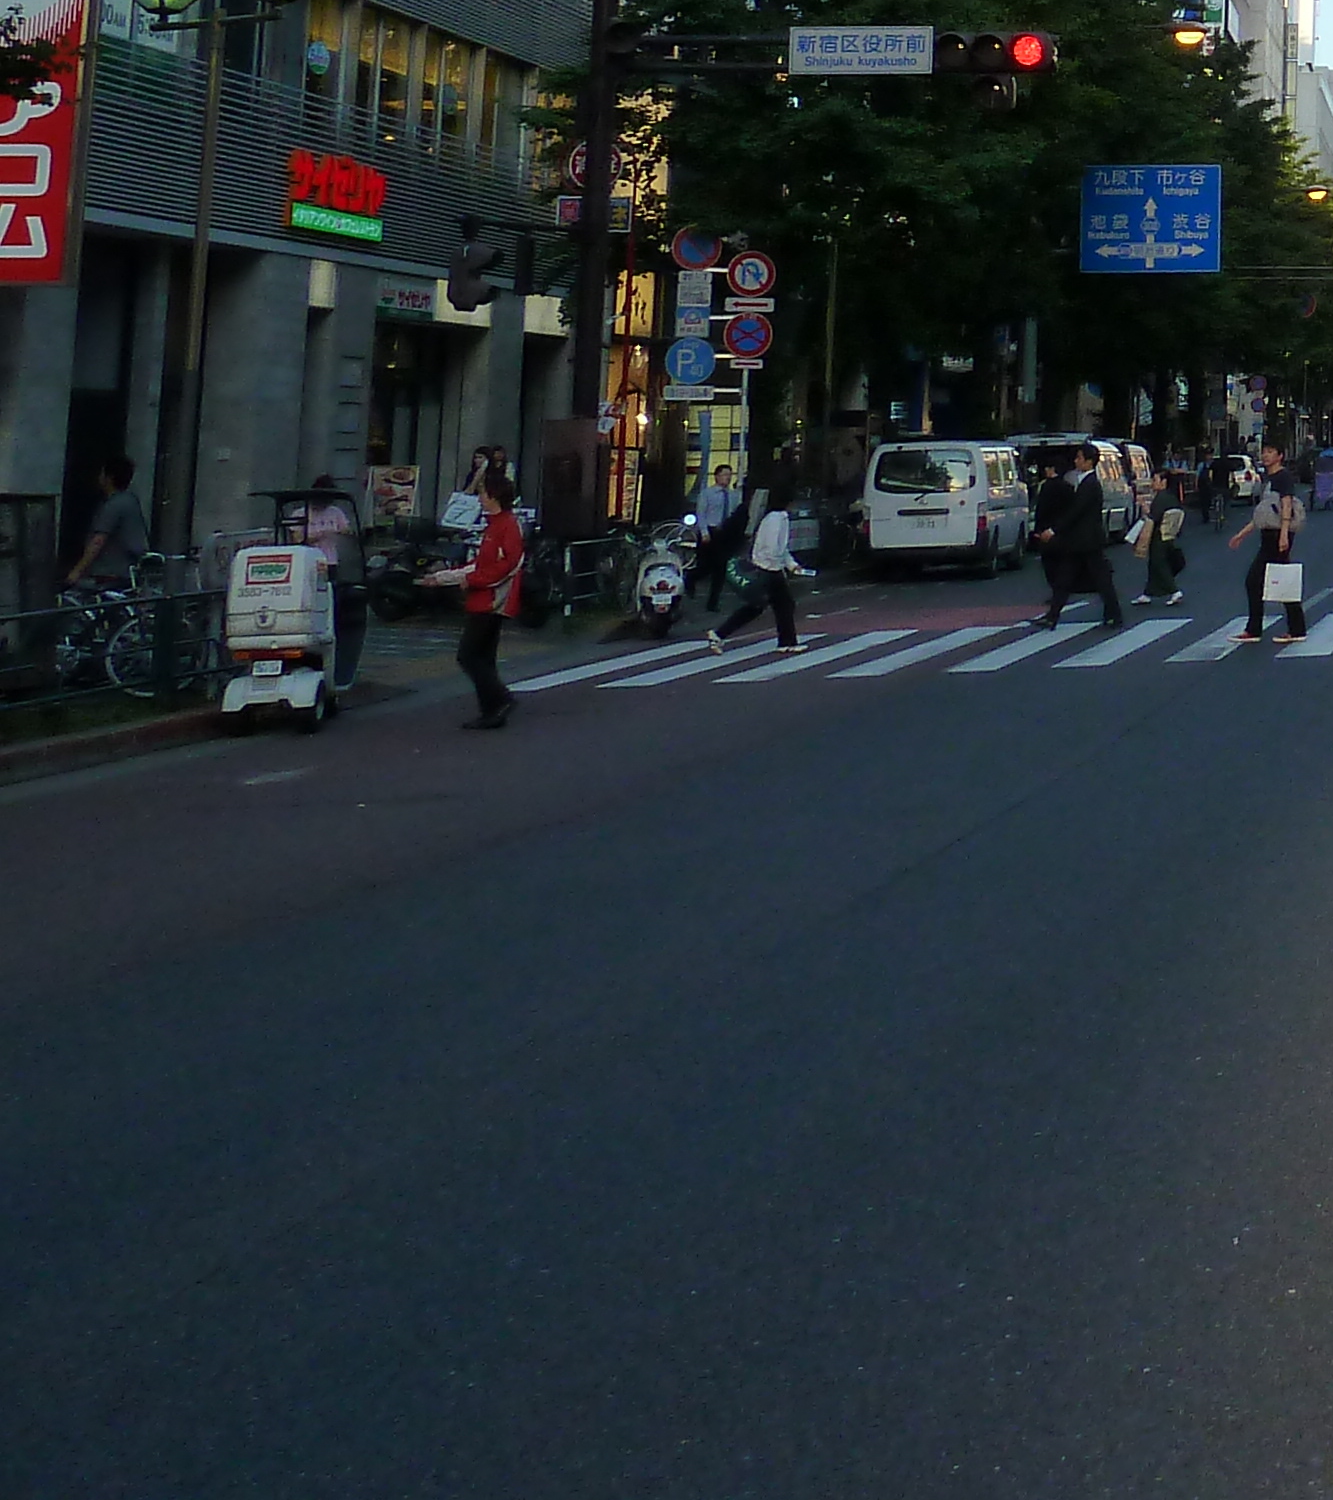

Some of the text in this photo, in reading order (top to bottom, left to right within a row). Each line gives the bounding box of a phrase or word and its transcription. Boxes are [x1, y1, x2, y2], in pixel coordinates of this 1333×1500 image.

[796, 34, 926, 54] 新宿区役所前
[804, 56, 917, 68] Shinjuku kuyakusho
[1094, 169, 1145, 185] 九段下
[1173, 213, 1211, 229] 渋谷
